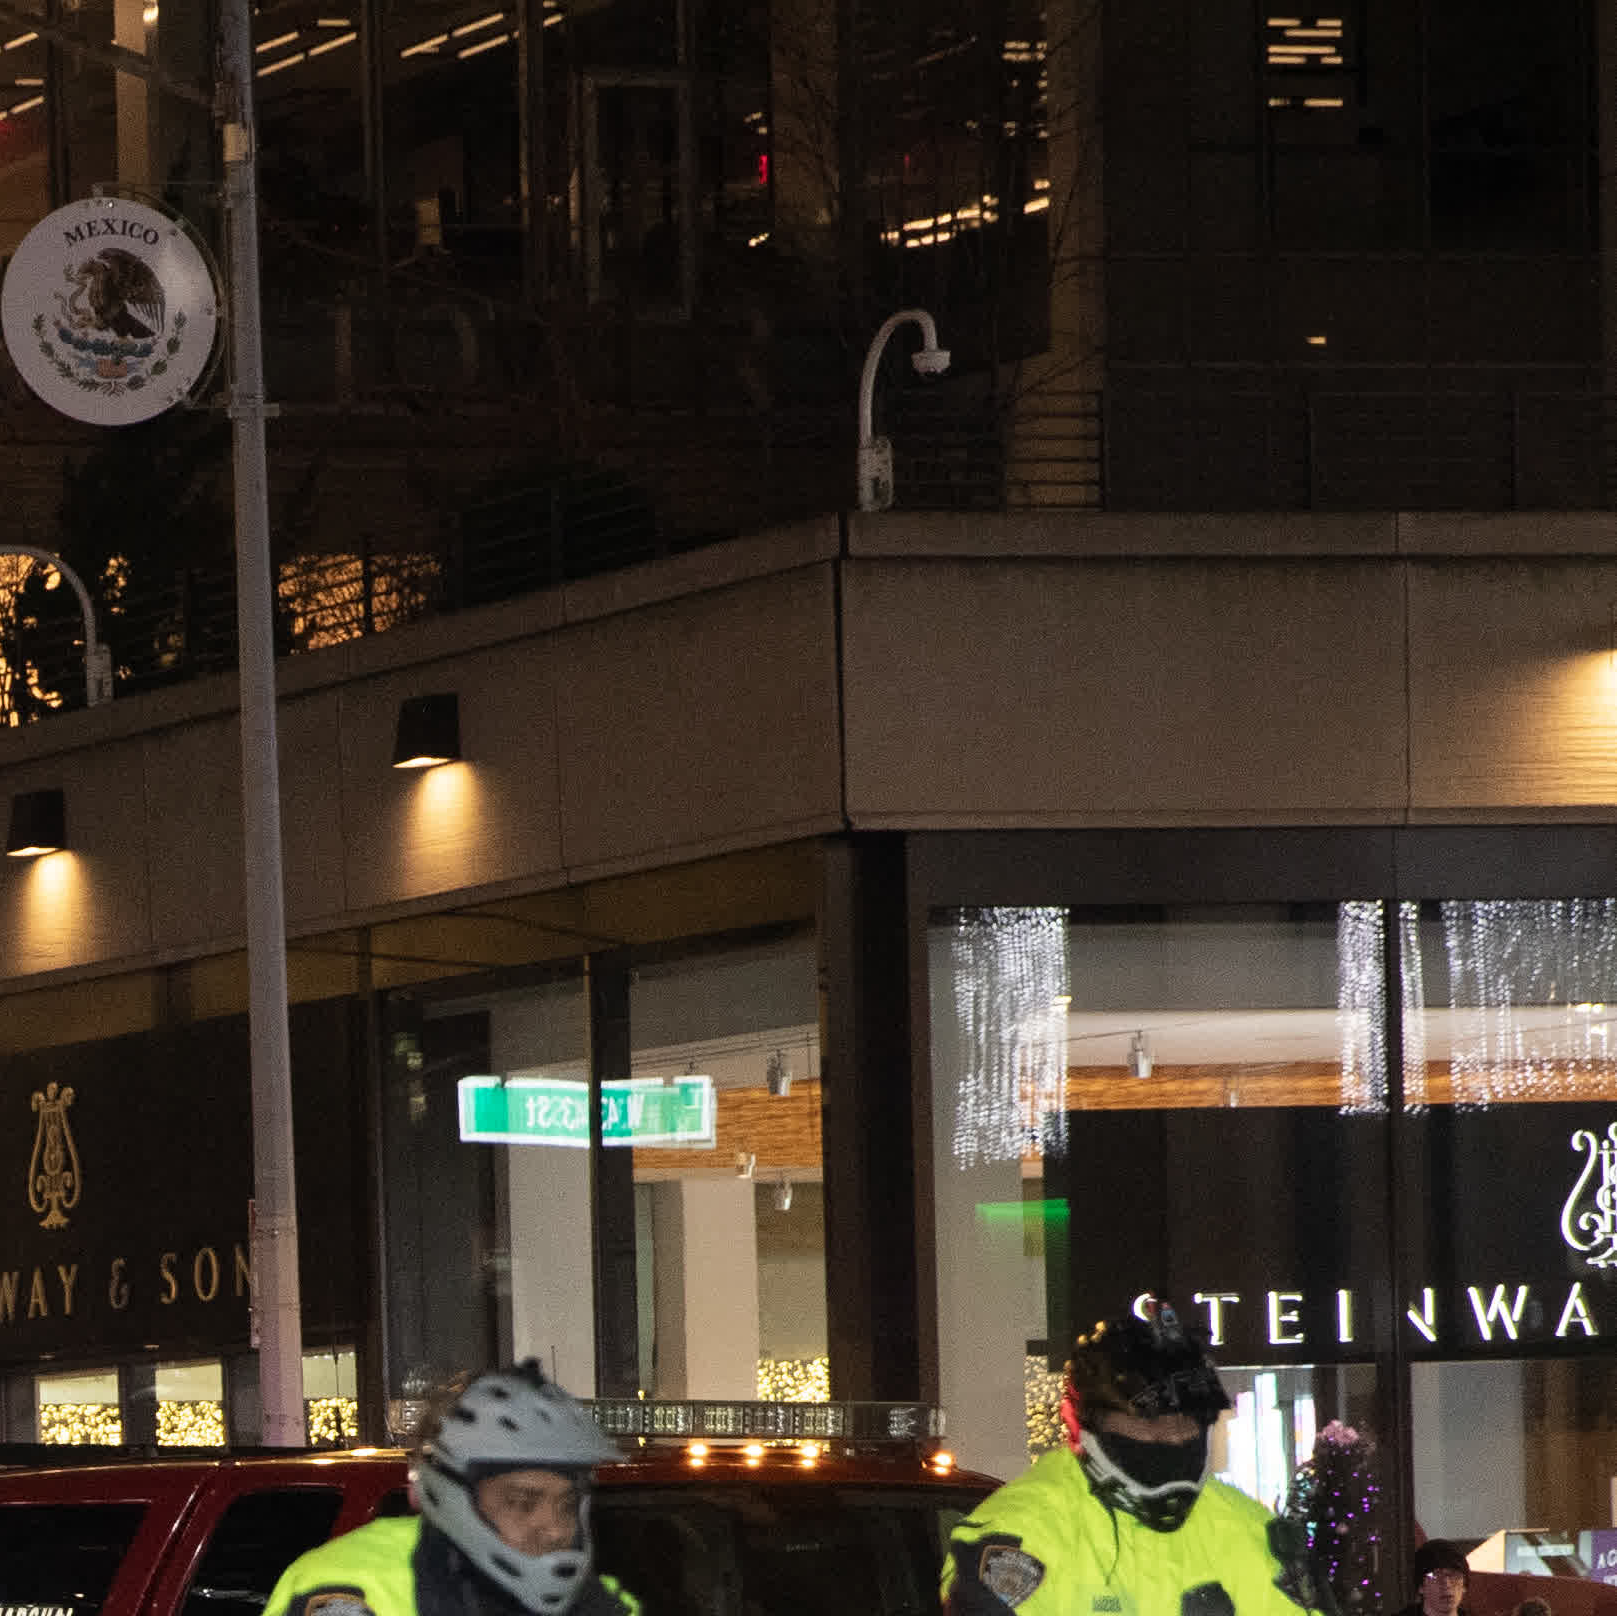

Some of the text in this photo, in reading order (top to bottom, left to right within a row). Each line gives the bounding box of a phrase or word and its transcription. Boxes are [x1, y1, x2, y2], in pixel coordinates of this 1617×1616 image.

[63, 217, 160, 247] MEXICO
[110, 1257, 129, 1310] &
[160, 1244, 262, 1305] SON
